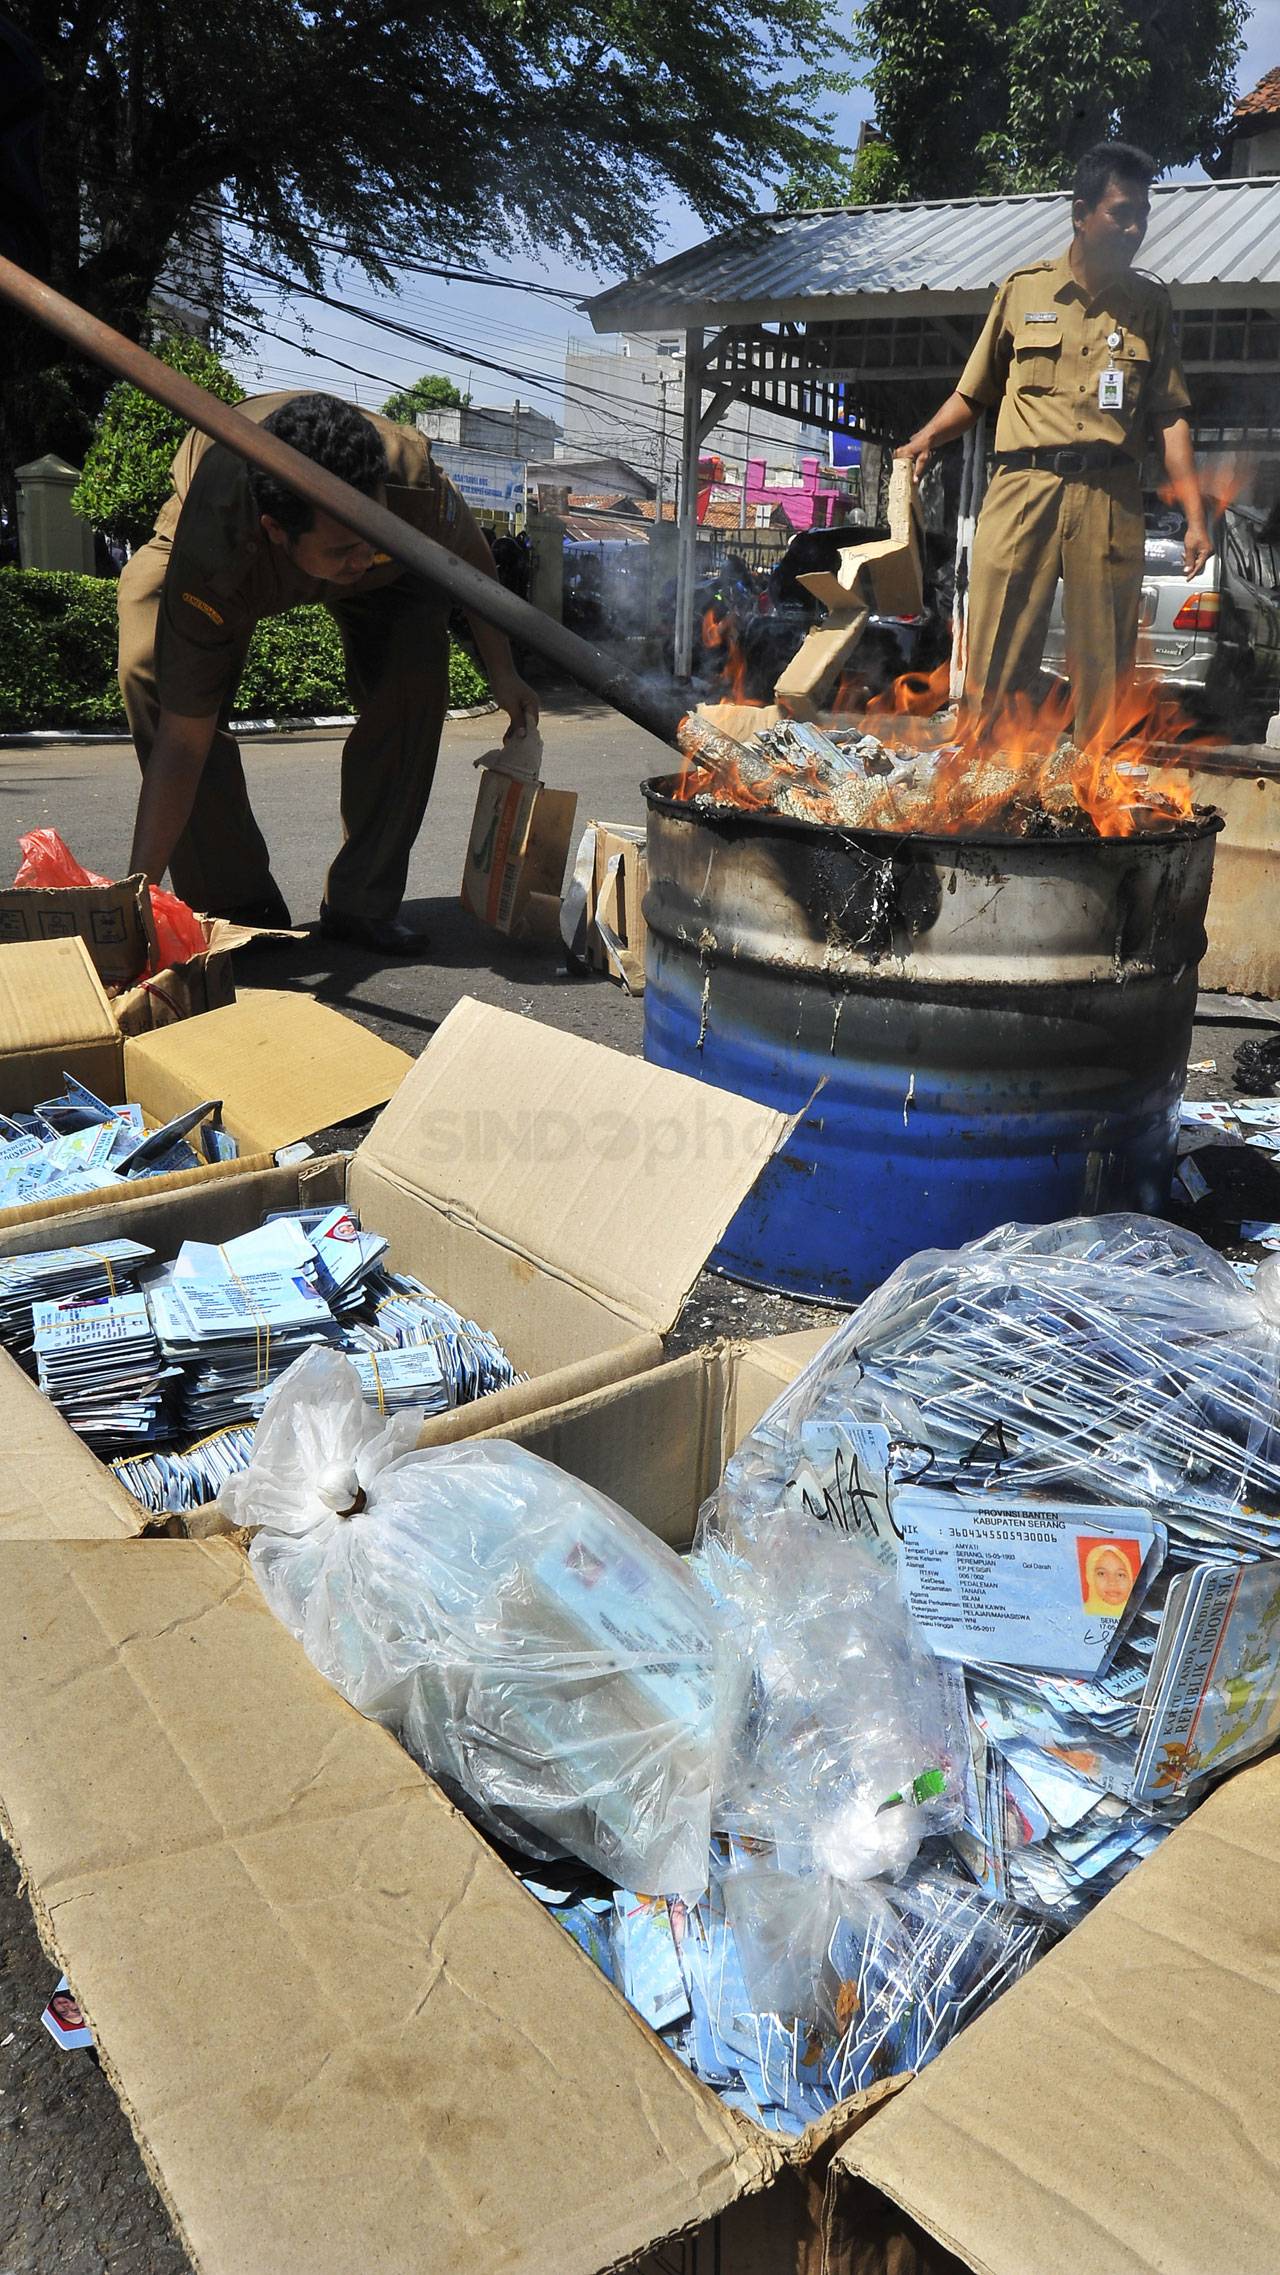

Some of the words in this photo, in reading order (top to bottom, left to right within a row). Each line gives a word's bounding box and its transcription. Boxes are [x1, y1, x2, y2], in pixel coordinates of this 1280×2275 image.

[978, 1509, 1022, 1519] PROVINSI
[1022, 1511, 1059, 1520] BANTEN
[973, 1517, 1026, 1527] KABUPATEN
[1027, 1520, 1066, 1529] SERANG
[902, 1525, 918, 1534] NIK
[957, 1558, 996, 1567] PEREMPUAN
[1163, 1694, 1182, 1736] KARTU
[1178, 1647, 1198, 1687] TANDA
[1191, 1574, 1220, 1642] PENDUDUK
[1175, 1662, 1208, 1734] REPUBLIK
[1200, 1572, 1235, 1656] INDONESIA
